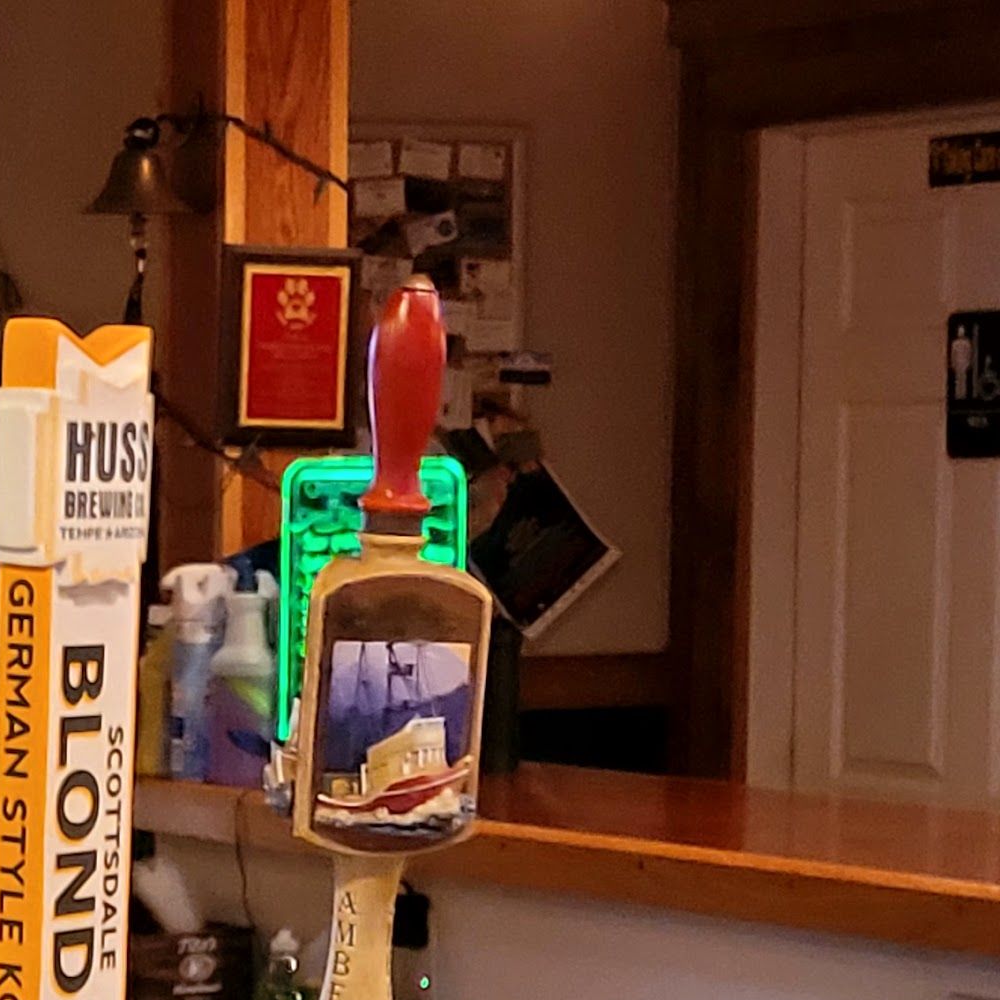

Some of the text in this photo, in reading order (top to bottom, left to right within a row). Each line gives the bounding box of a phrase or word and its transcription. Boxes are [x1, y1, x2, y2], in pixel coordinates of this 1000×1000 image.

[65, 420, 150, 483] HUSS
[3, 579, 35, 779] GERMAN
[100, 726, 123, 971] SCOTTSDALE
